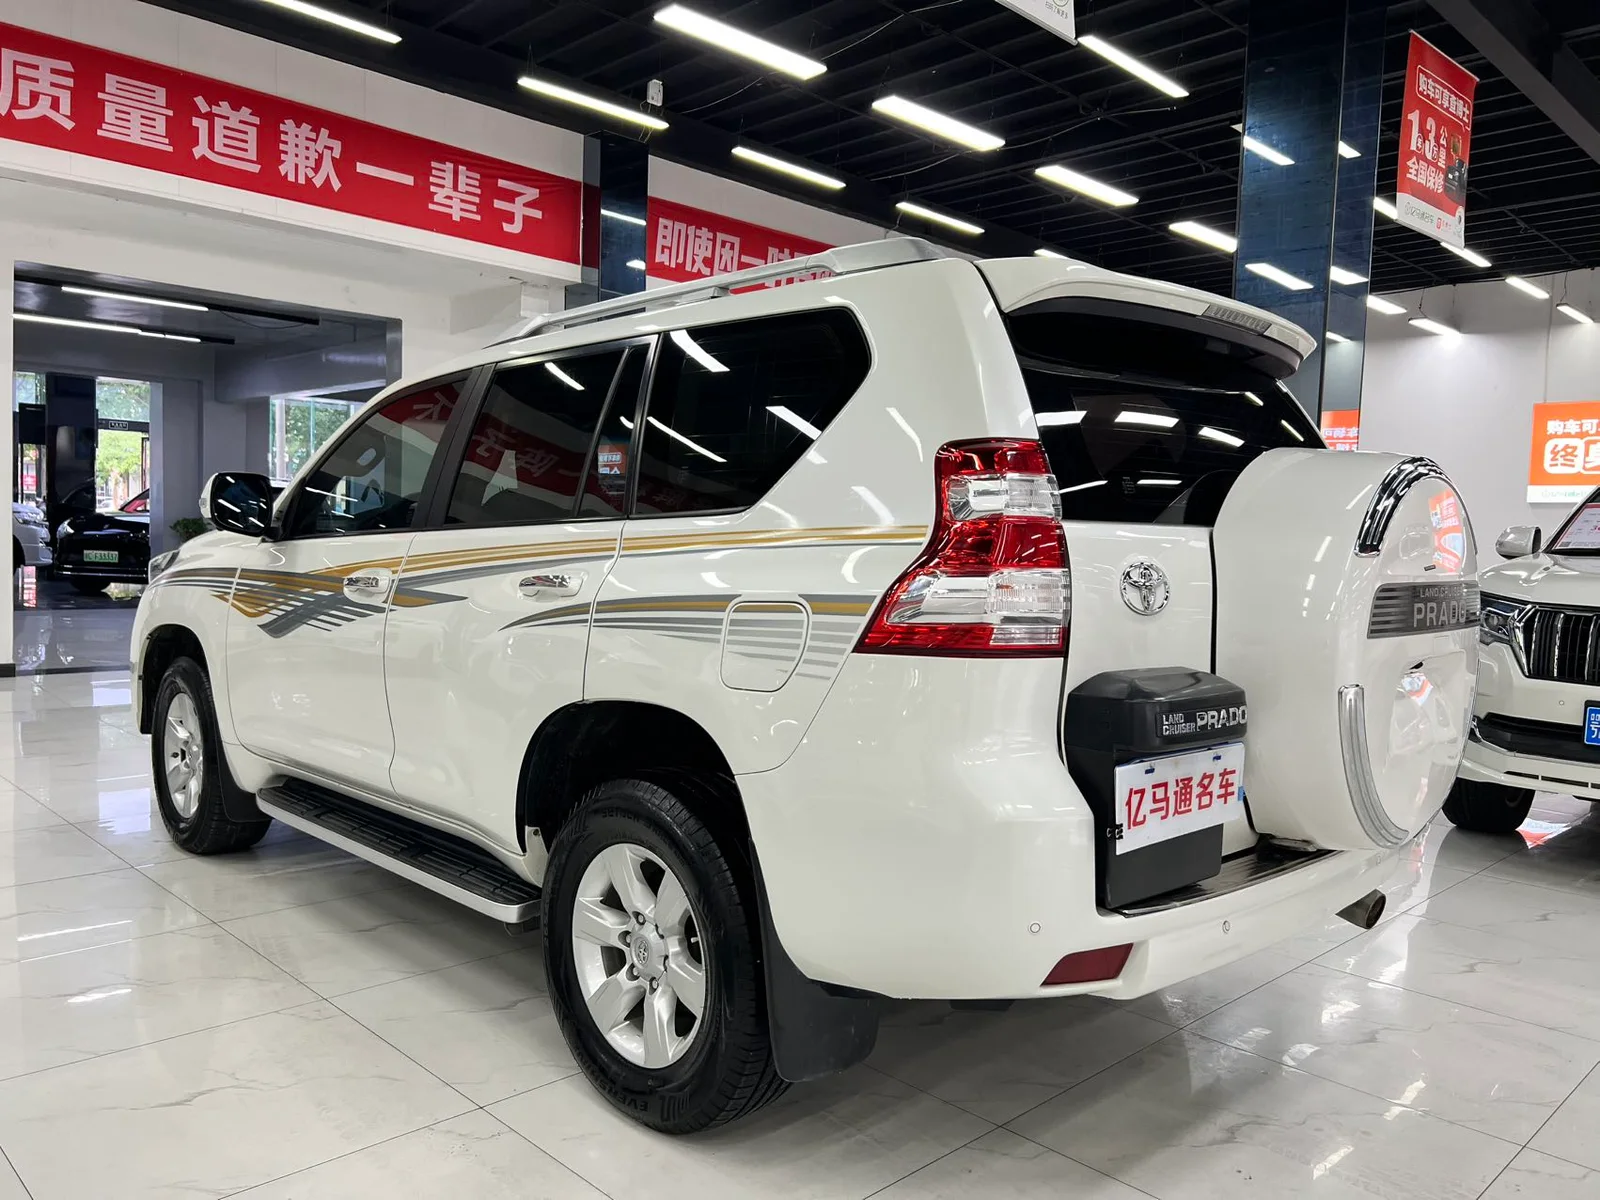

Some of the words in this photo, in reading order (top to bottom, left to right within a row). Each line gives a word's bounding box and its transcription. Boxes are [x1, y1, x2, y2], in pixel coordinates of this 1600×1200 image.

[0, 47, 543, 235] 质量道歉一辈子
[1406, 156, 1444, 194] 全国保修
[1546, 419, 1600, 435] 购车可
[1413, 600, 1467, 628] PRADO
[1162, 713, 1185, 725] LAND
[1162, 723, 1196, 736] CRUISER
[1196, 705, 1248, 732] PRADO
[1125, 768, 1236, 830] 亿马通名车
